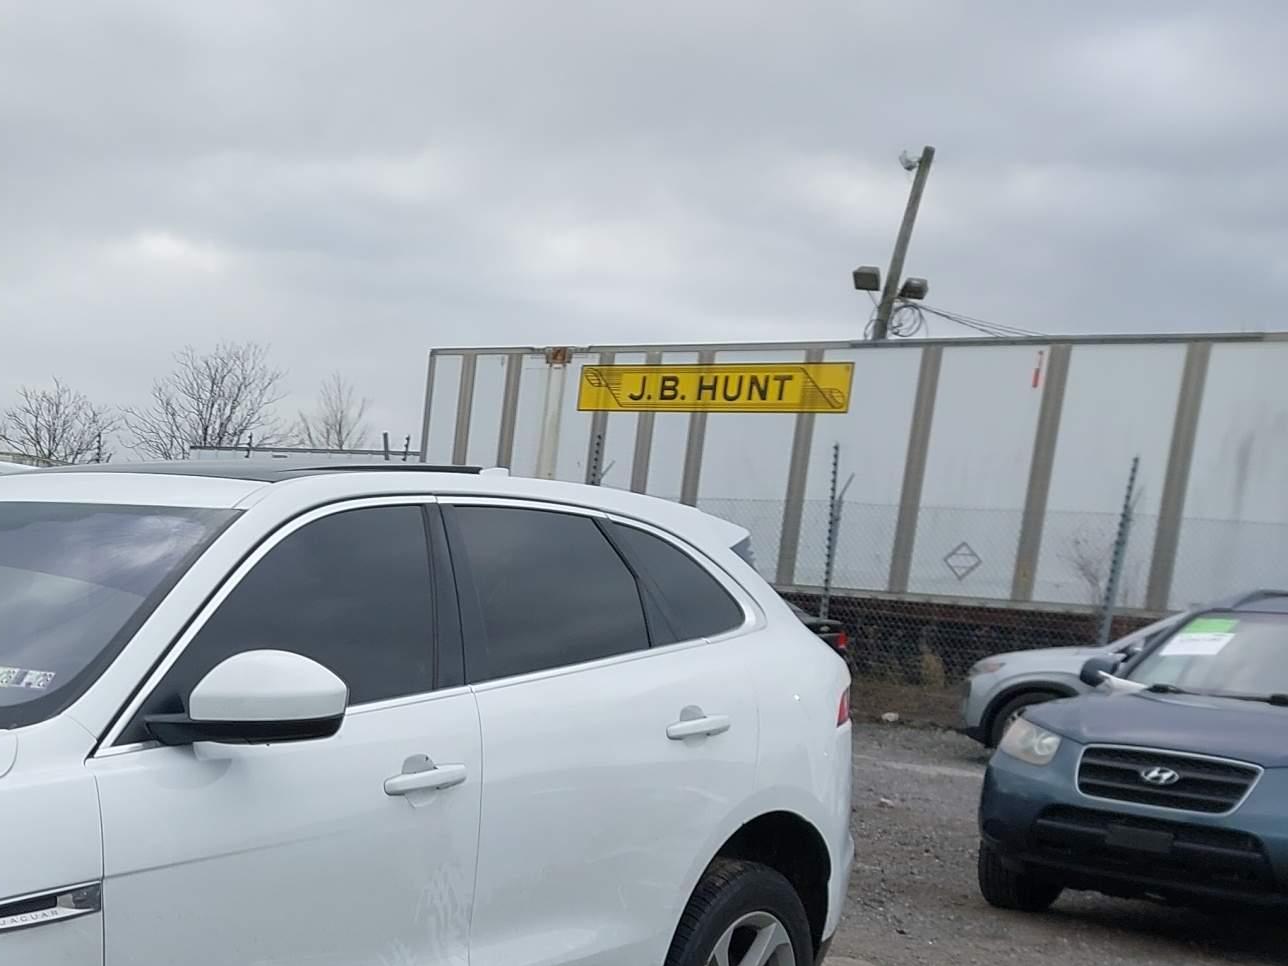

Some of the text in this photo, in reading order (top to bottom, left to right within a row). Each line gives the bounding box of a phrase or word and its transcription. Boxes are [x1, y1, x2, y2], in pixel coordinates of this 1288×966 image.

[629, 375, 793, 401] J.B. HUNT
[0, 910, 59, 926] JAGUAR
